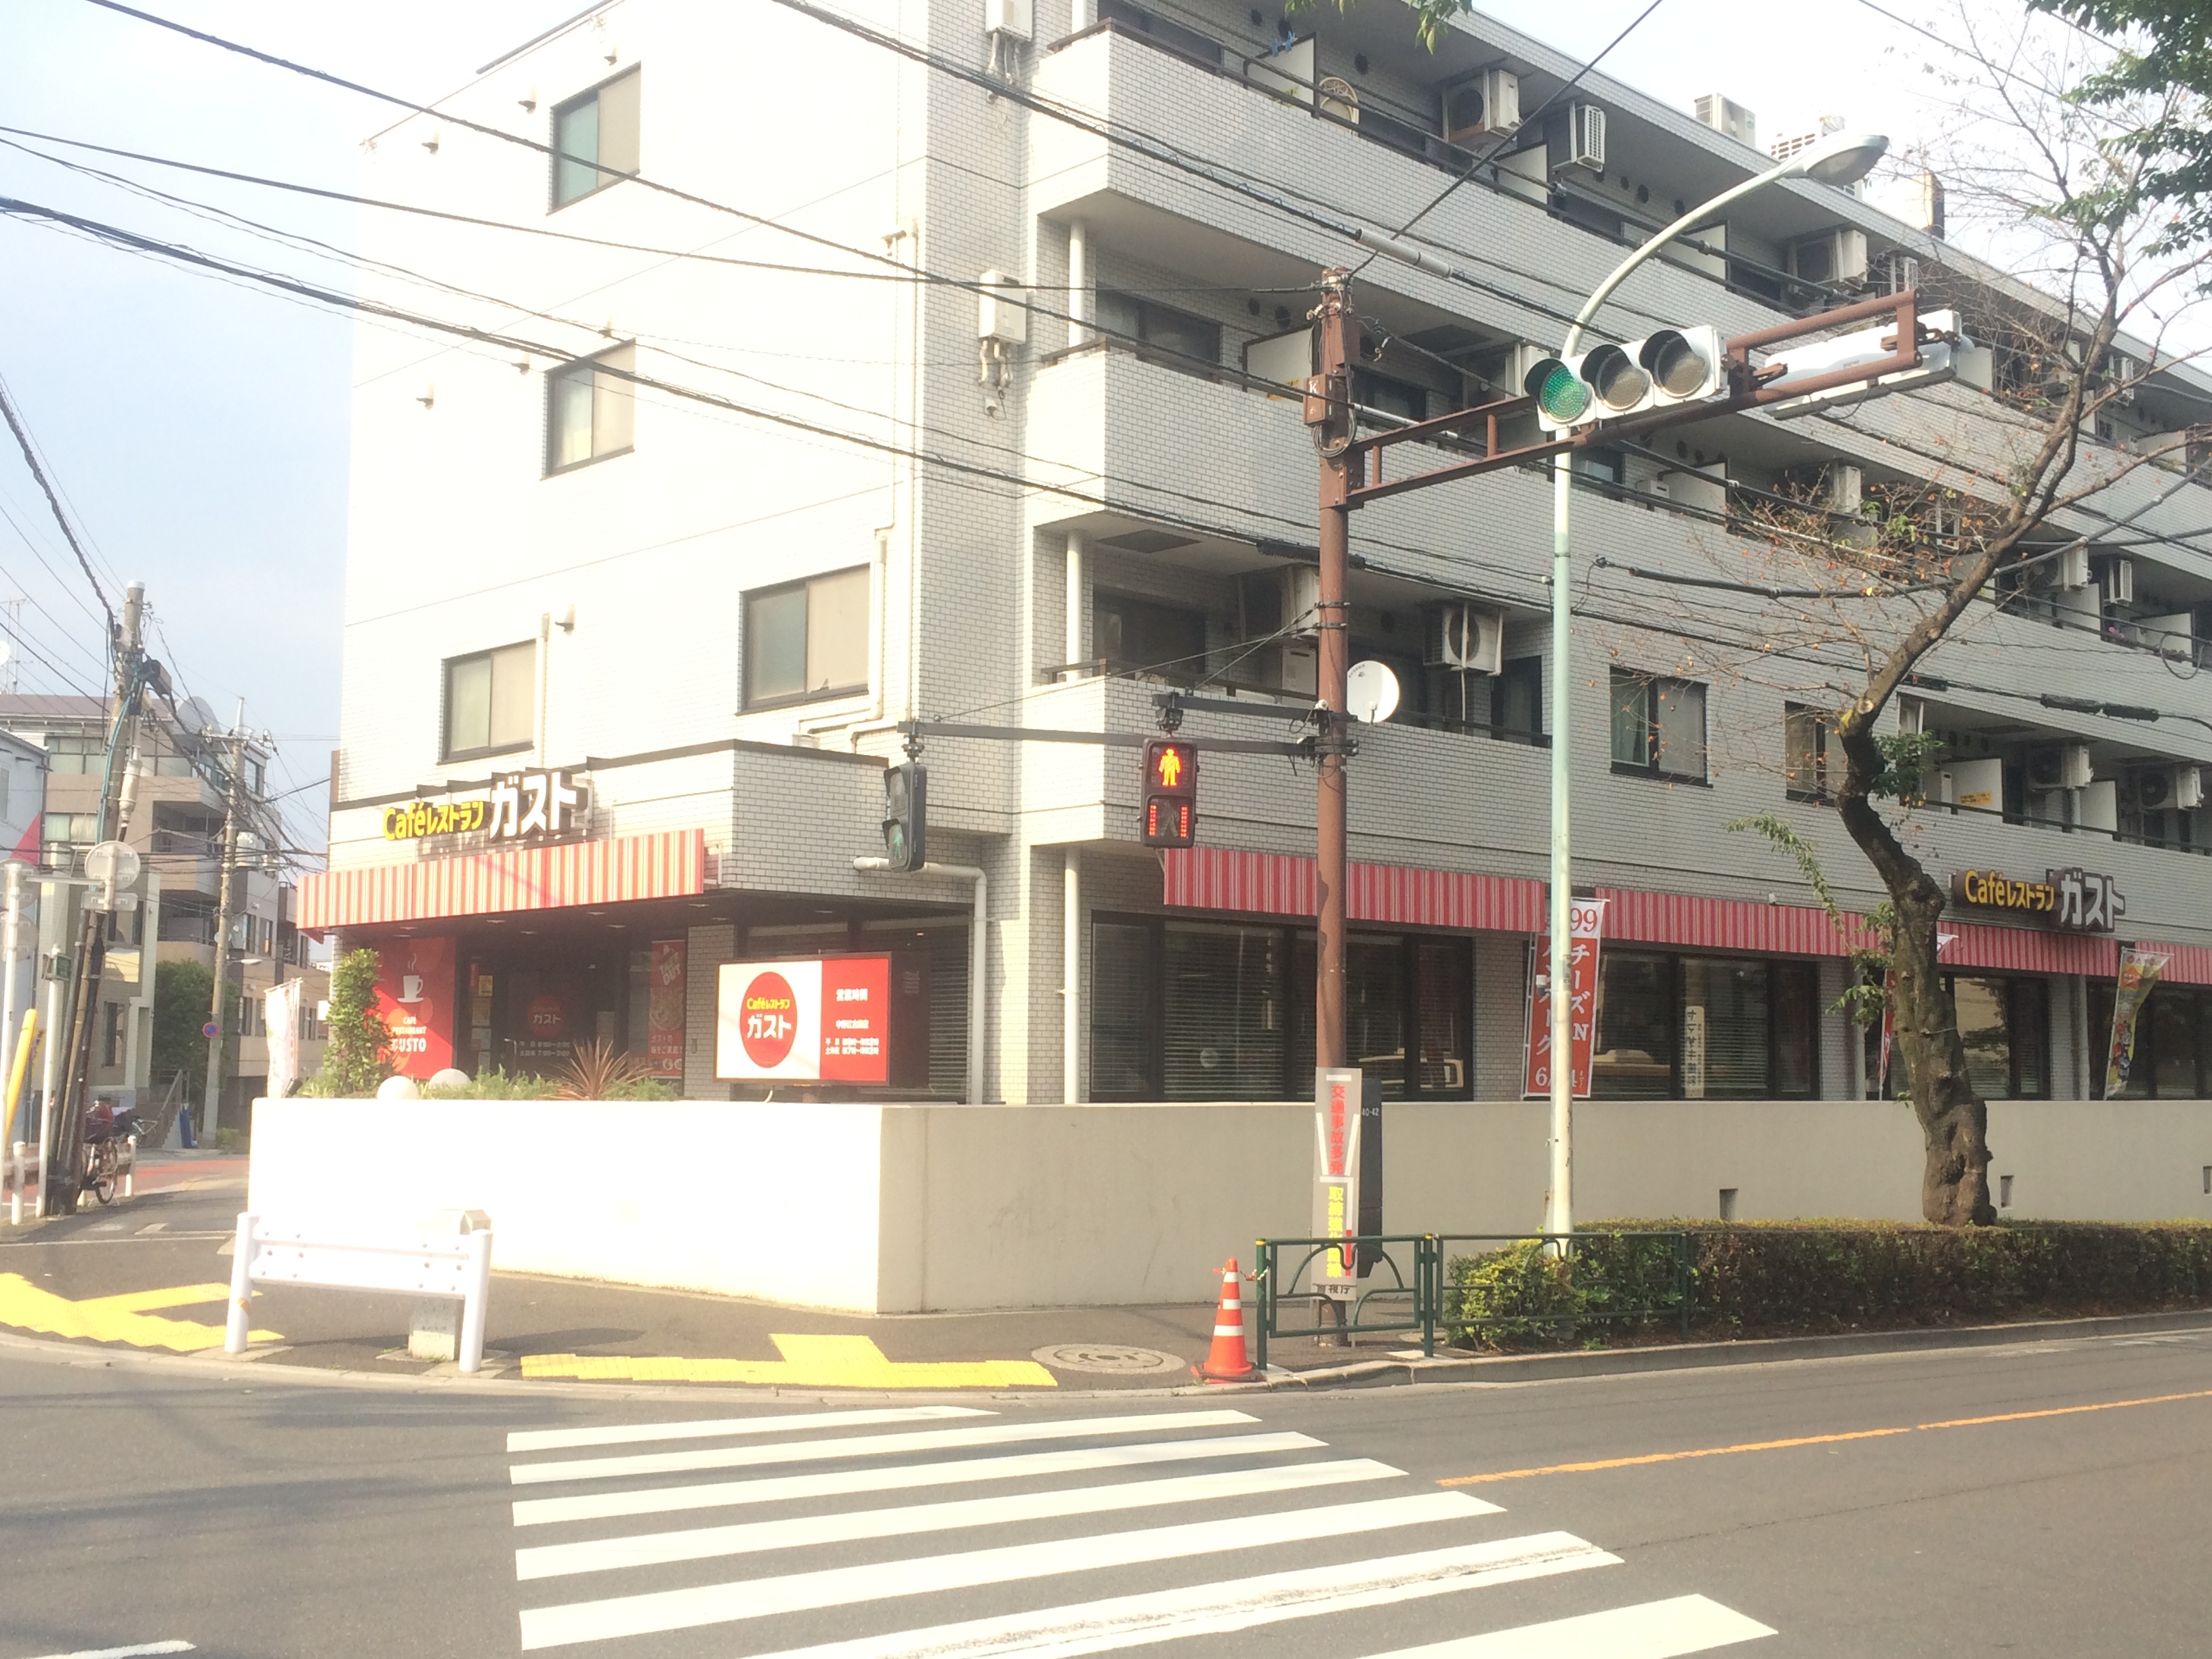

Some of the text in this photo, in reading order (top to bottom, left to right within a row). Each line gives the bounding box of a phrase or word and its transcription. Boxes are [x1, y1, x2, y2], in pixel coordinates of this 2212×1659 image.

[383, 771, 577, 840] Caféレストラン ガスト
[1965, 869, 2125, 929] Caféレストラン ガスト
[1570, 907, 1598, 933] 99
[663, 964, 680, 985] OUT
[747, 997, 790, 1010] Caféレストラン
[533, 1013, 561, 1024] ガスト
[747, 1013, 792, 1039] ガスト
[1330, 1084, 1345, 1175] 交通事故多発
